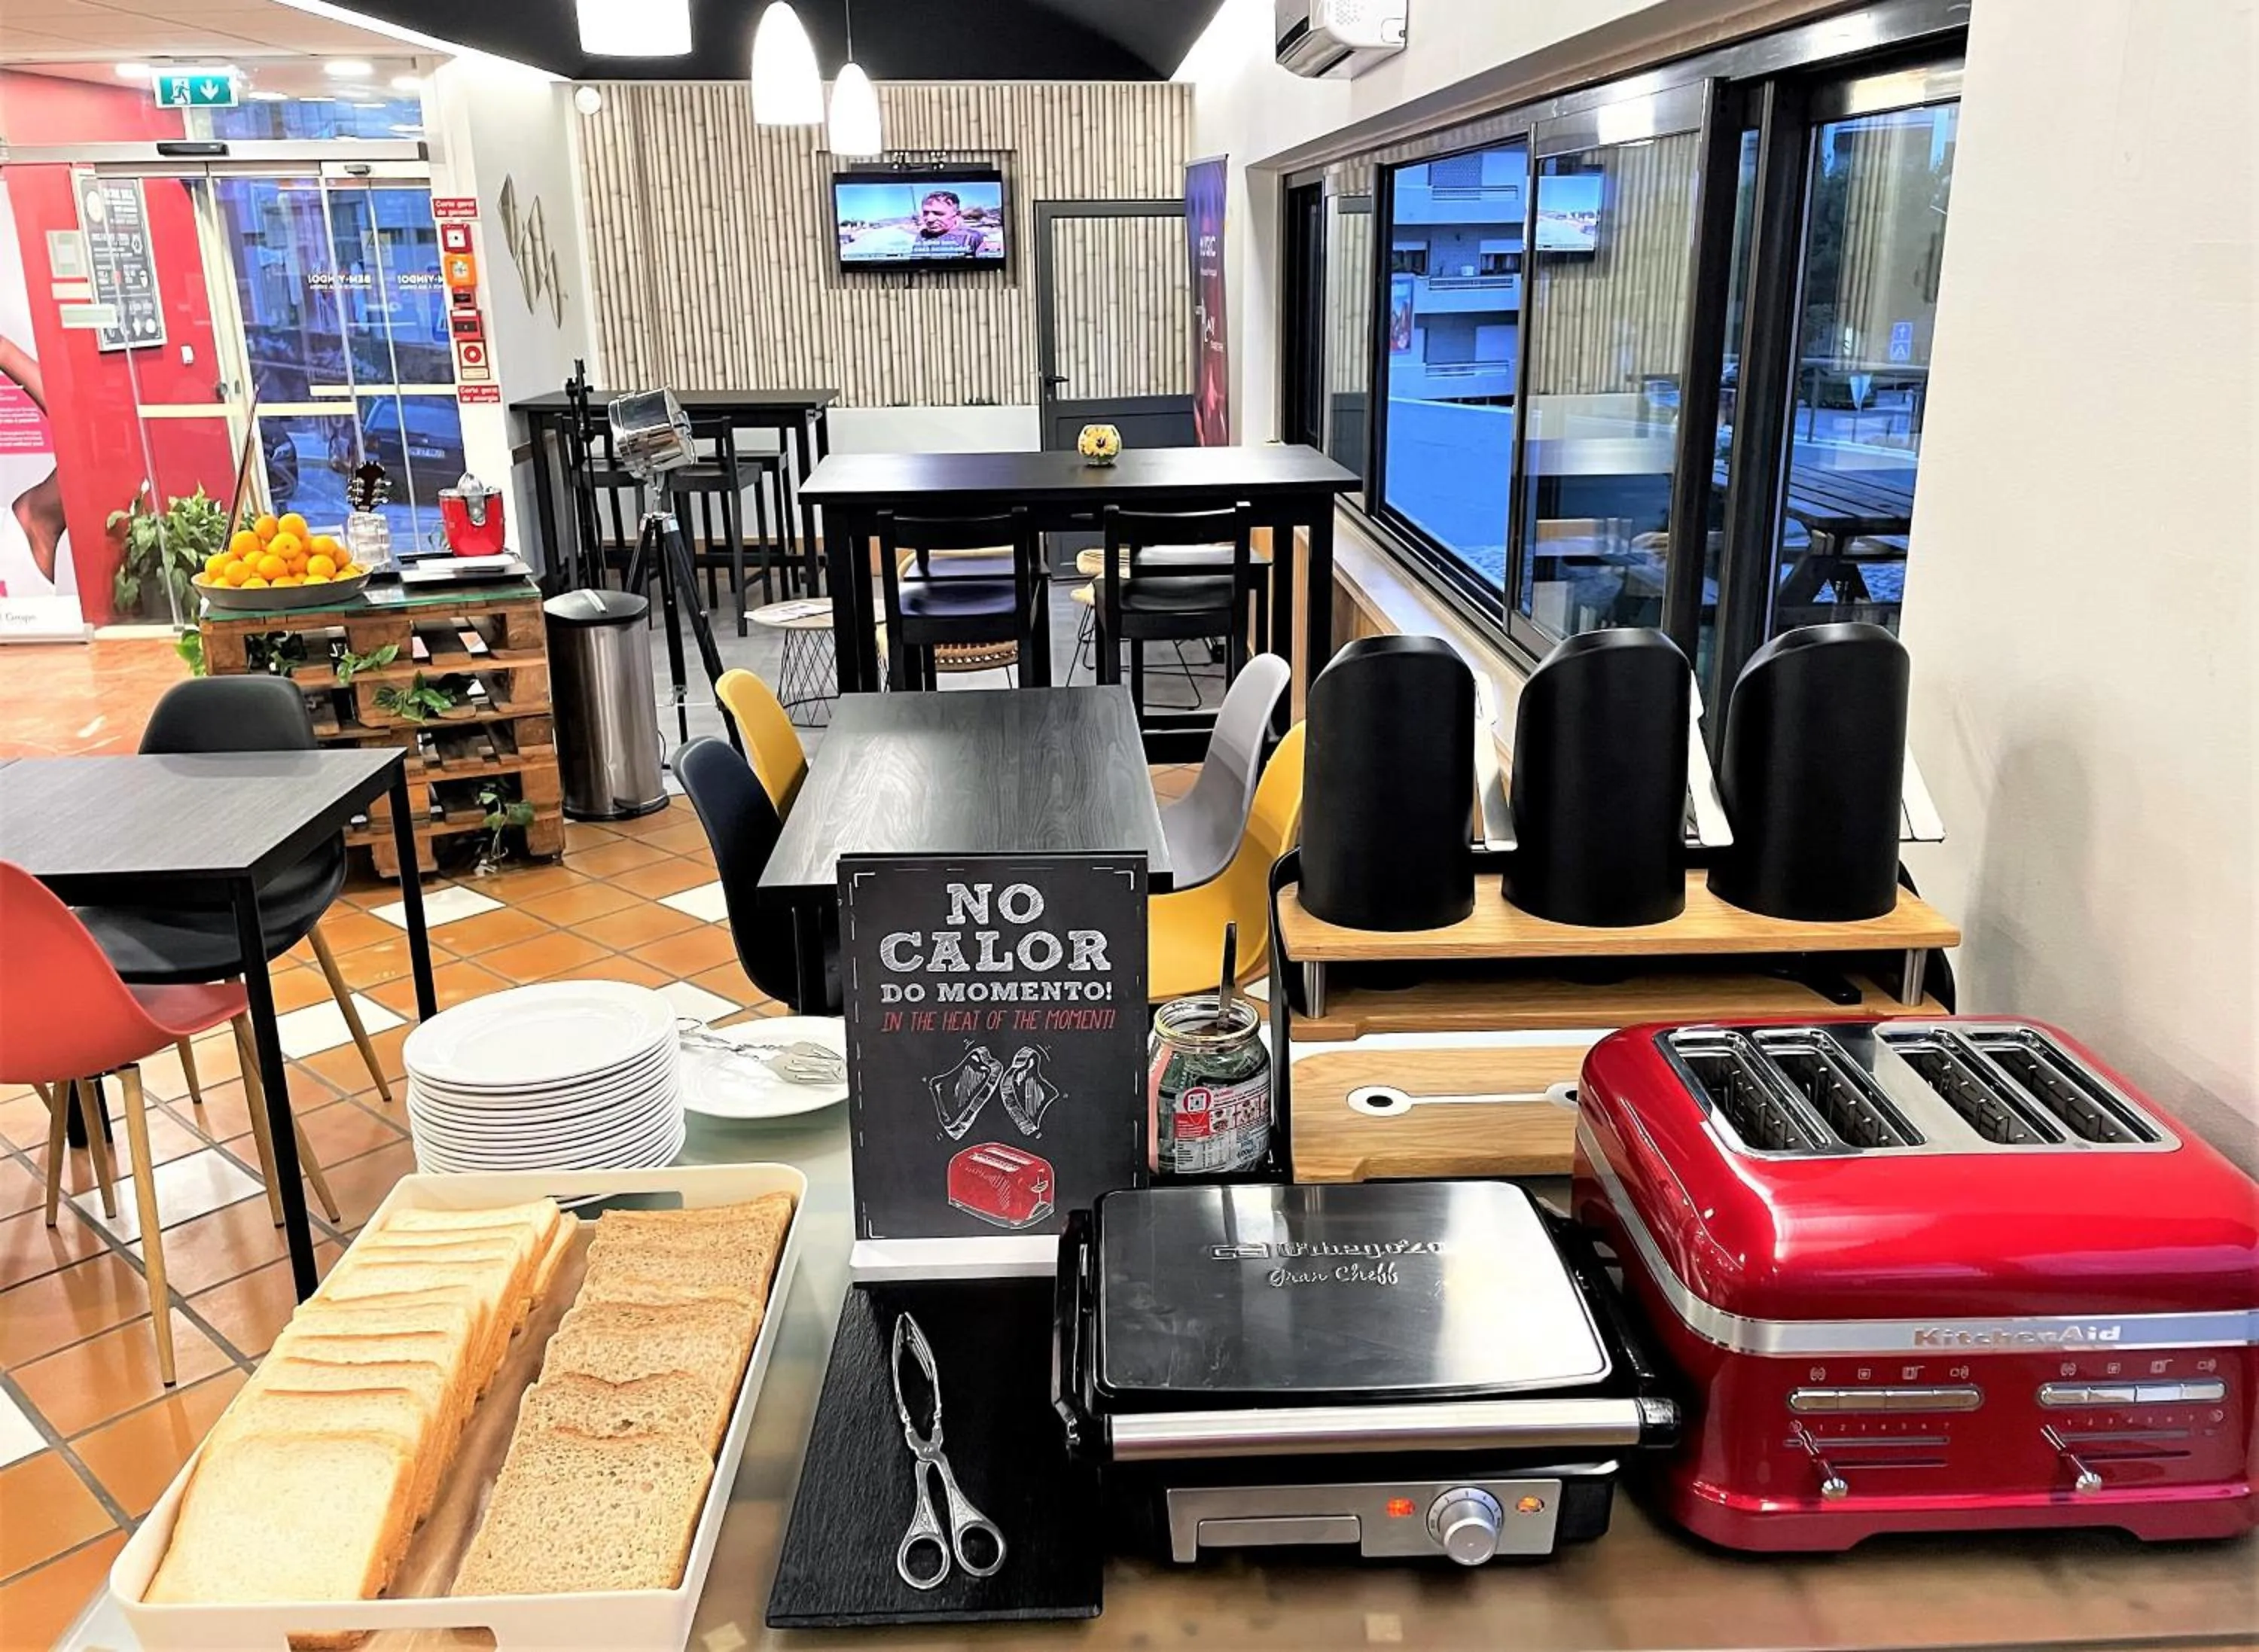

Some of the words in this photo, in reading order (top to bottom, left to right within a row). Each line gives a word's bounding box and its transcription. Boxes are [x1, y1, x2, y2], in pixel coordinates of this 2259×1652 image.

[946, 882, 1045, 925] NO
[880, 930, 1112, 972] CALOR
[880, 983, 926, 1003] DO
[937, 981, 1112, 1002] MOMENTO!
[881, 1012, 903, 1032] IN
[910, 1010, 937, 1032] THE
[942, 1010, 981, 1031] HEAT
[986, 1010, 1008, 1031] OF
[1013, 1010, 1042, 1030] THE
[1044, 1009, 1116, 1029] MOMENT!
[1913, 1324, 2121, 1346] KitchenAid
